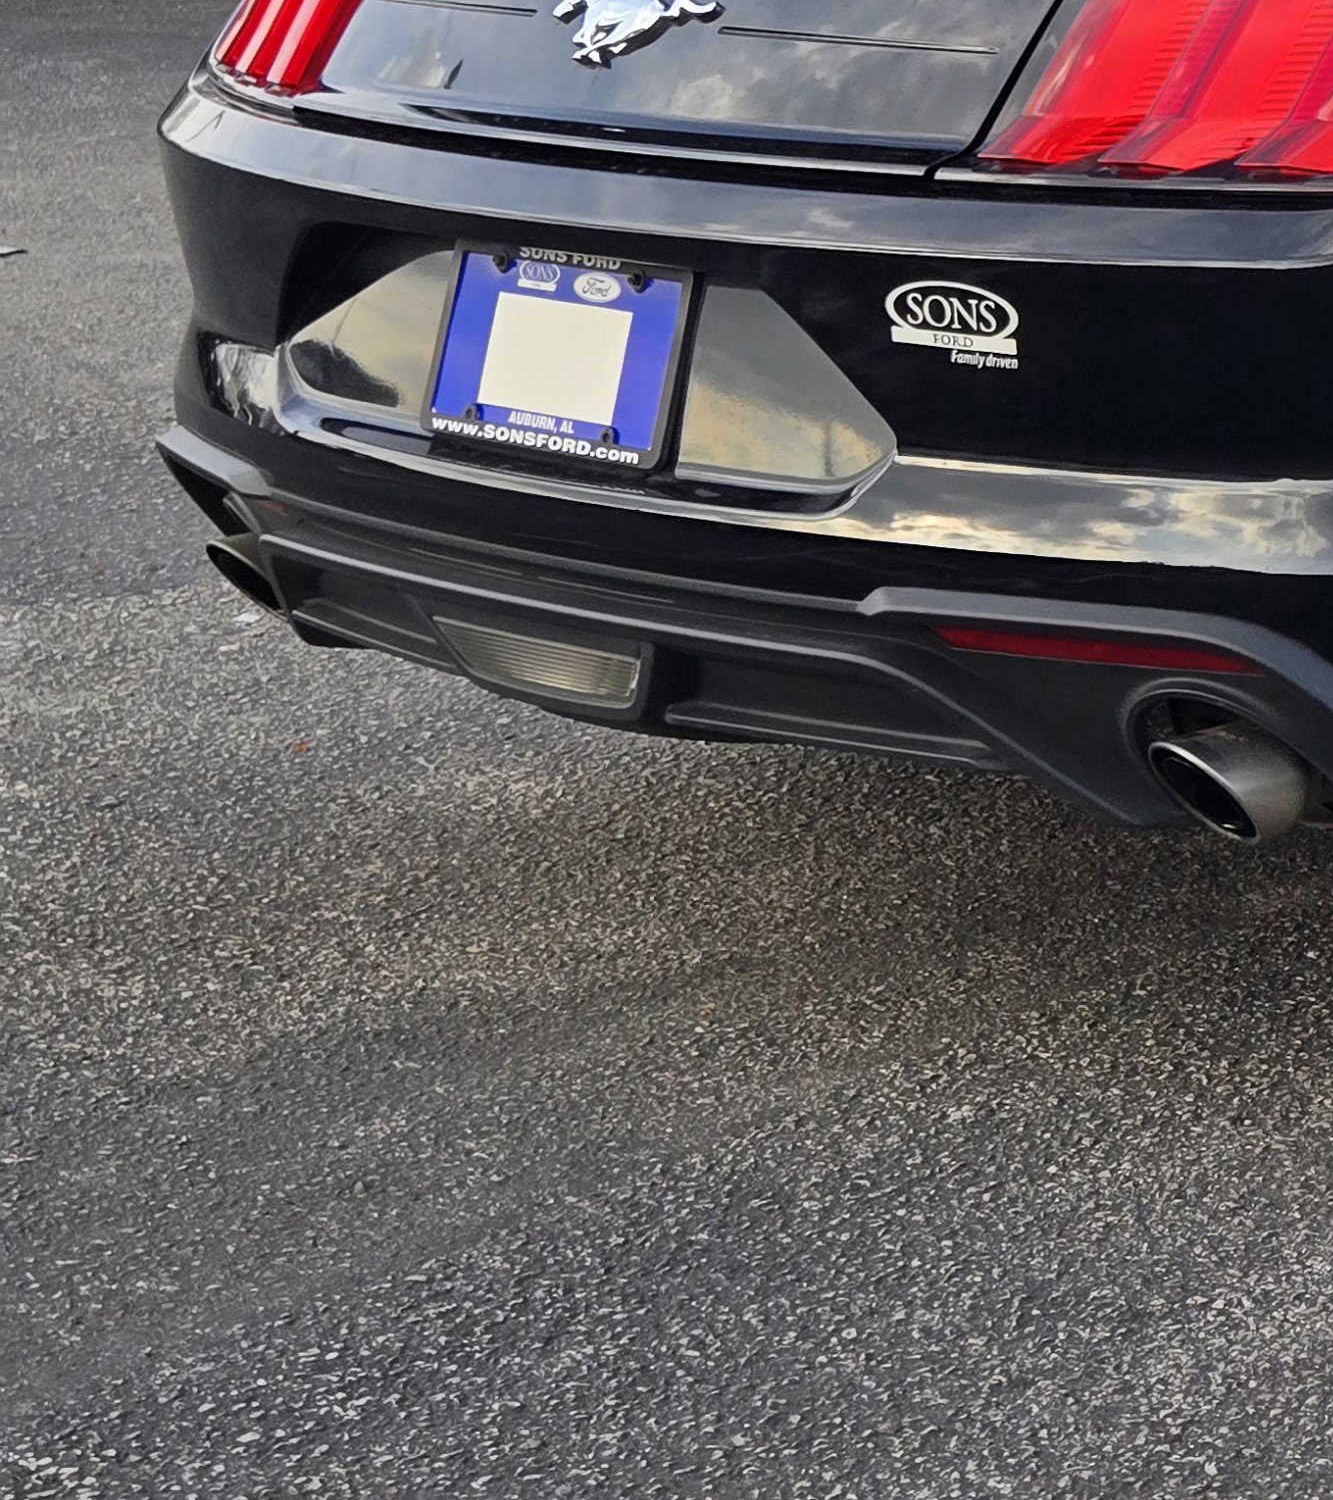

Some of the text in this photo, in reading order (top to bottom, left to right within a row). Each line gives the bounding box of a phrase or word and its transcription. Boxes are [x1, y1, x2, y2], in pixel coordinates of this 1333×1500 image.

[582, 276, 612, 297] Ford
[906, 292, 997, 333] SONS
[932, 333, 974, 348] FORD
[950, 350, 1019, 369] Family driven
[508, 410, 574, 434] AUBURN, AL
[432, 416, 640, 465] www.SONSFORD.com
